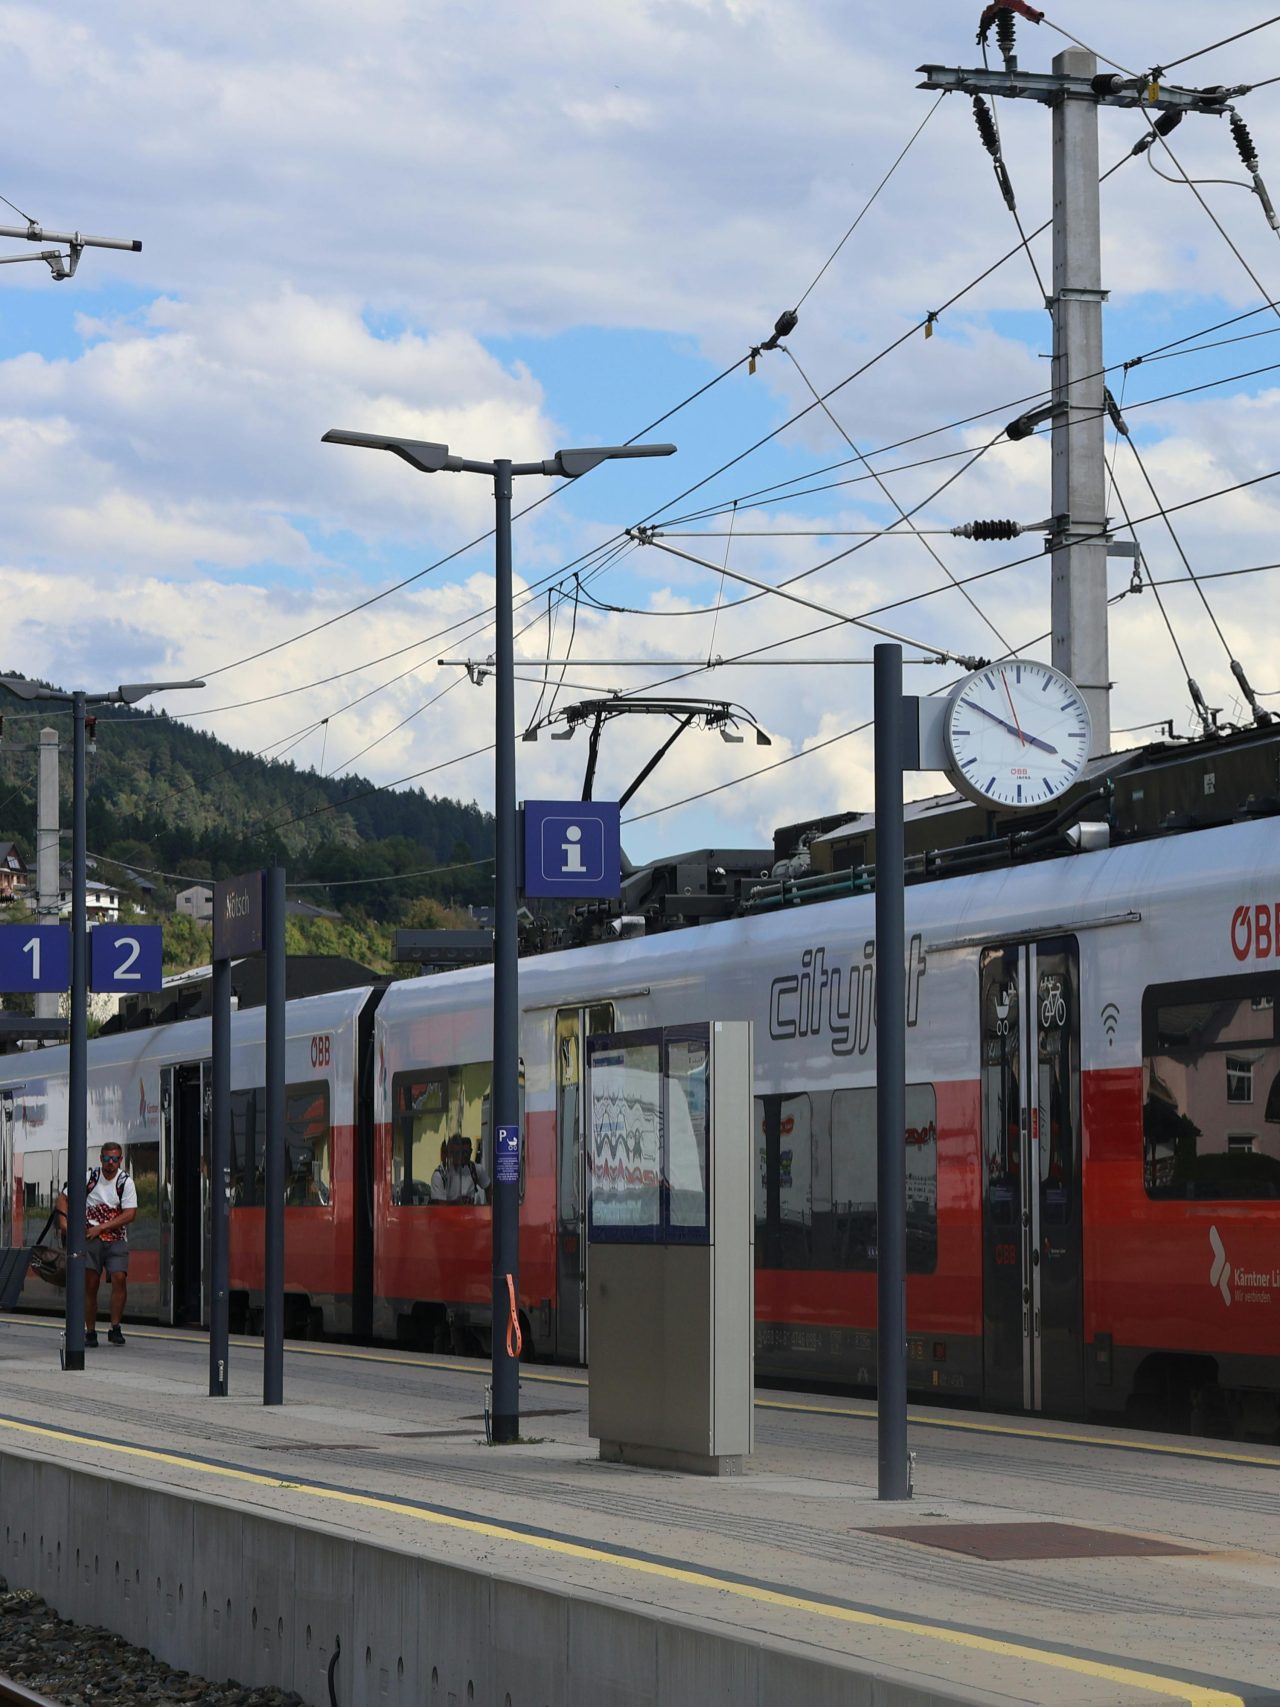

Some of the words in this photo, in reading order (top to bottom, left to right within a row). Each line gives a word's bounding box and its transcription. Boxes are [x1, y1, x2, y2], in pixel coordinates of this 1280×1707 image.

[226, 887, 250, 920] Nötsch
[22, 937, 41, 980] 1
[113, 937, 141, 980] 2
[769, 933, 927, 1057] cityjt
[310, 1035, 331, 1068] ÖBB
[499, 1129, 507, 1143] P
[1234, 1267, 1270, 1288] Kärntner
